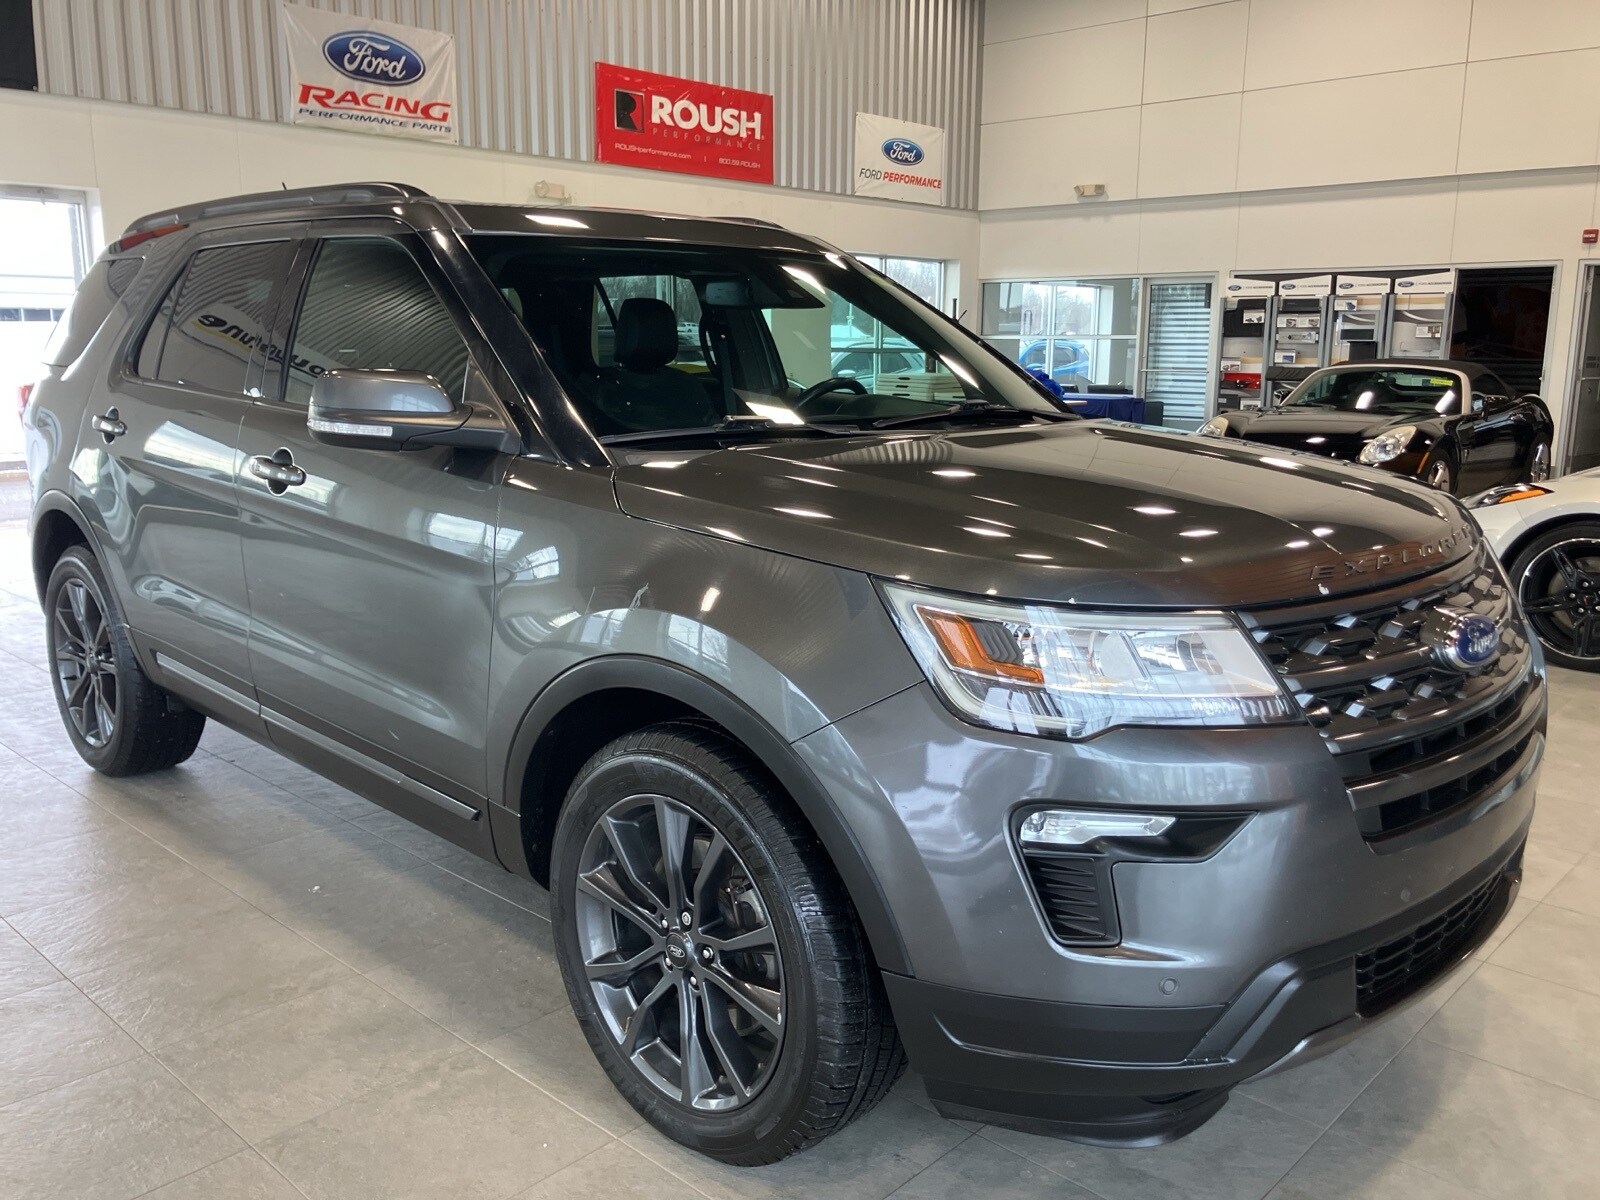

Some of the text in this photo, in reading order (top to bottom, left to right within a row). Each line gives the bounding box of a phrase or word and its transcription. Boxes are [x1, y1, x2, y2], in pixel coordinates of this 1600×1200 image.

[343, 38, 407, 80] Ford
[298, 84, 452, 123] RACING
[298, 108, 452, 133] PERFORMANCE PARTS
[651, 95, 762, 140] ROUSH
[652, 128, 761, 151] PERFORMANCE
[889, 141, 917, 162] Ford
[859, 168, 942, 189] FORD PERFORMANCE
